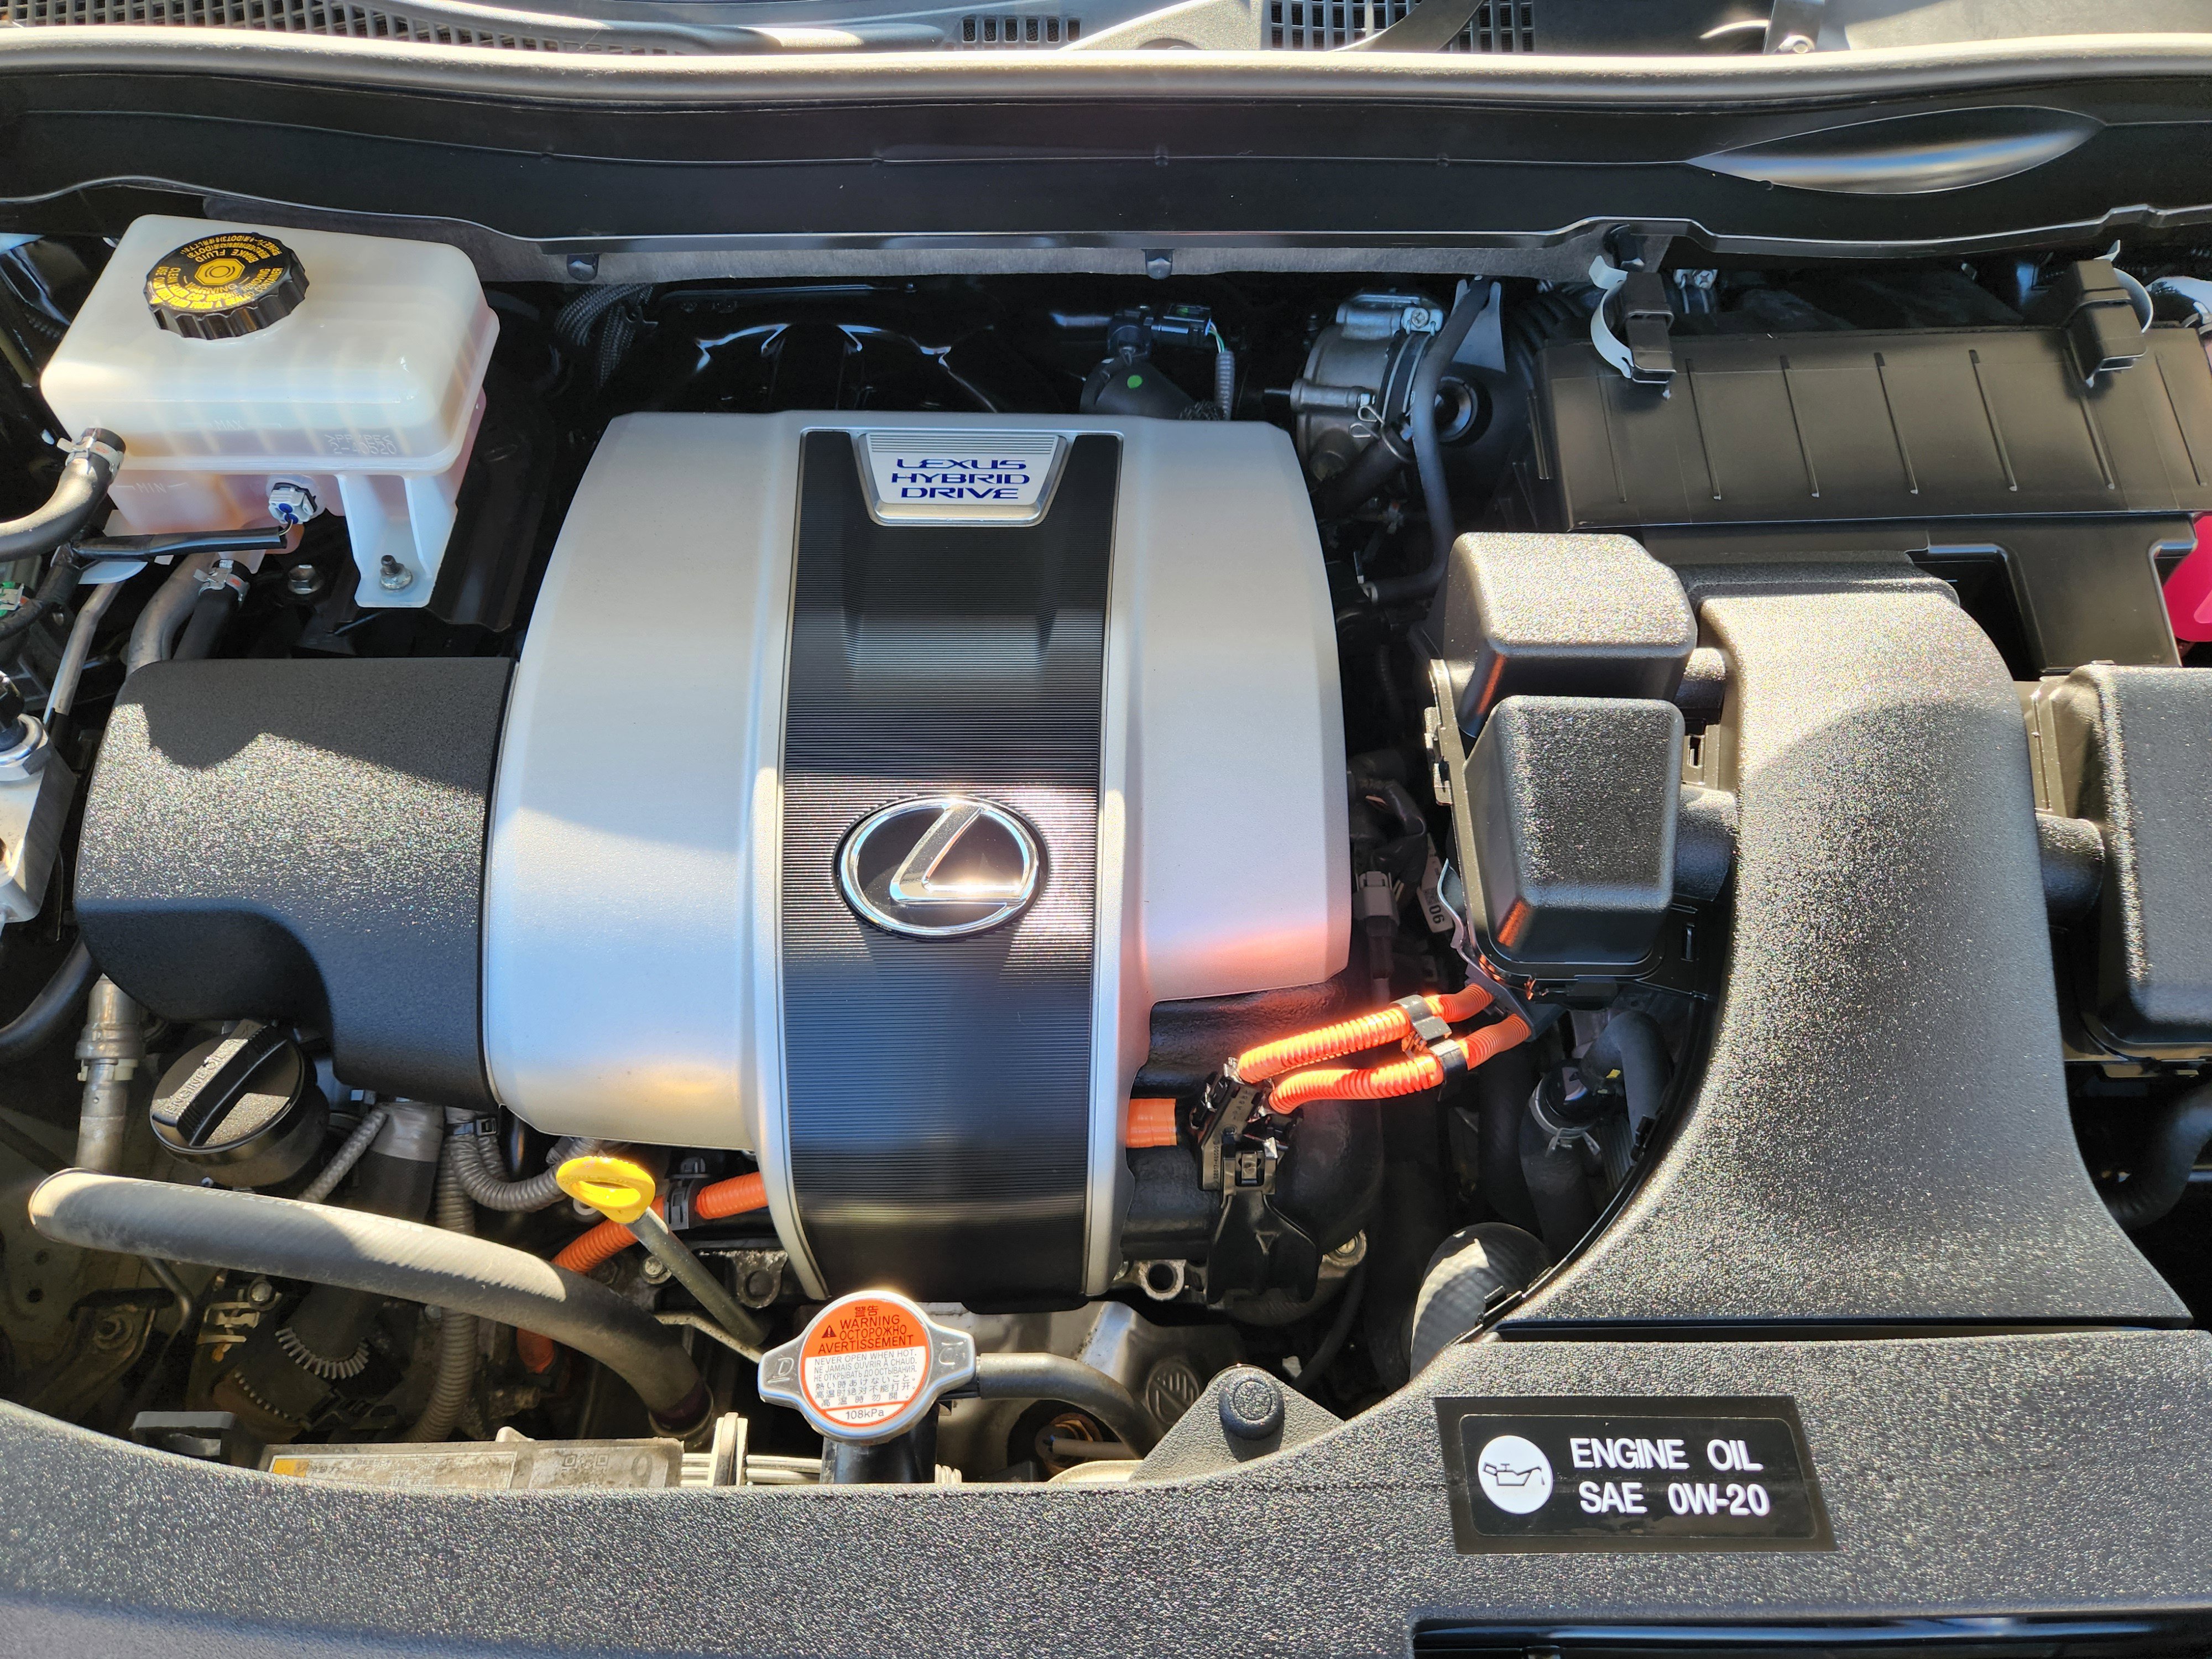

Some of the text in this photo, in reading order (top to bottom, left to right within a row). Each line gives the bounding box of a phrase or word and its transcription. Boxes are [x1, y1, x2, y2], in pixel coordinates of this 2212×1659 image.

[195, 249, 259, 263] BRAKE FLUID
[155, 266, 168, 276] USE
[225, 291, 256, 305] SEALED
[254, 268, 283, 292] CONTAINER
[167, 267, 181, 283] CLEAN
[205, 289, 241, 301] BEFORE
[242, 268, 270, 291] REMOVING
[184, 283, 239, 294] WARNING
[215, 419, 244, 431] MAX
[896, 458, 1027, 470] LEXUS
[891, 472, 1030, 485] HYBRID
[135, 482, 167, 493] MIN
[900, 487, 1019, 499] DRIVE
[165, 1049, 227, 1115] ENGINE OIL
[854, 1305, 878, 1317] 警告
[840, 1314, 900, 1329] WARNING
[839, 1325, 906, 1340] ОСТОРОЖНО
[818, 1335, 914, 1354] AVERTISSEMENT
[815, 1357, 842, 1365] NEVER
[845, 1353, 867, 1362] OPEN
[870, 1351, 894, 1359] WHEN
[825, 1363, 852, 1373] JAMAIS
[854, 1360, 881, 1370] OUVRIR
[891, 1357, 917, 1366] CHAUD.
[824, 1371, 862, 1381] ОТКРЫВАТЬ
[864, 1369, 873, 1378] ДО
[875, 1365, 917, 1376] ОСТЫВАНИЯ.
[816, 1374, 915, 1390] 熱い時あけないこと。
[846, 1408, 884, 1420] 108kPa
[1571, 1437, 1763, 1471] ENGINE OIL
[1578, 1481, 1770, 1516] SAE 0W-20
